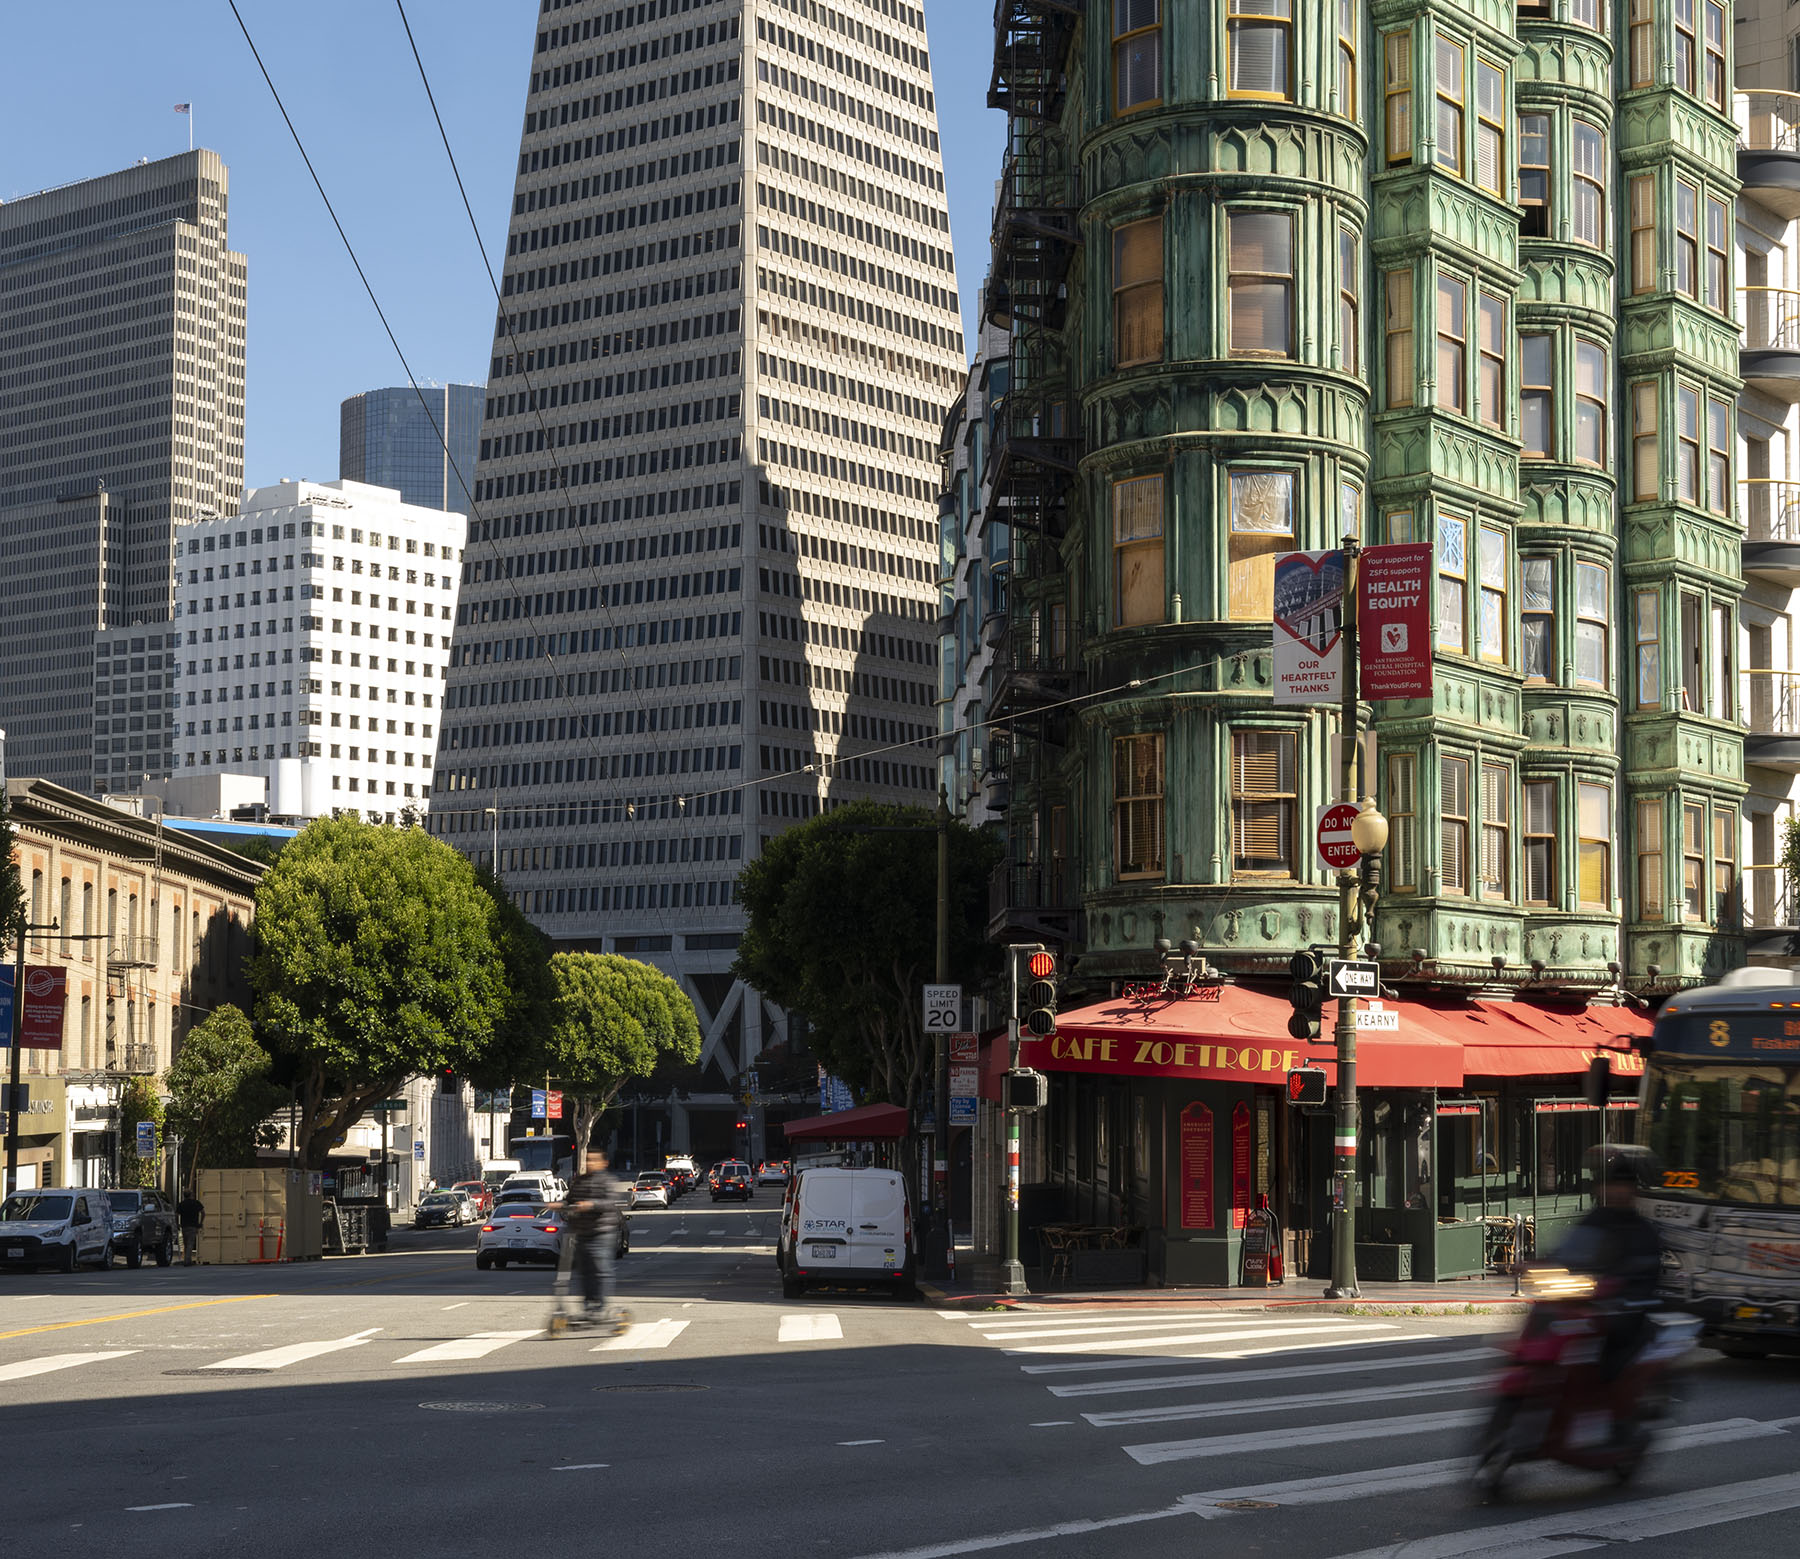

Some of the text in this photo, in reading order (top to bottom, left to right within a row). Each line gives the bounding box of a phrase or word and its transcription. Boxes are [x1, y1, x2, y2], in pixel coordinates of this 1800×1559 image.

[1385, 555, 1412, 564] support
[1369, 567, 1421, 576] ZSFG supports
[1367, 579, 1421, 594] HEALTH
[1368, 595, 1420, 610] EQUITY
[1298, 660, 1319, 669] OUR
[1281, 671, 1337, 682] HEARTFELT
[1288, 684, 1330, 694] THANKS
[1370, 681, 1422, 690] ThankYouSF.org
[1324, 817, 1337, 829] DO
[1328, 845, 1357, 857] ENTER
[1345, 972, 1373, 985] ONE WAY
[927, 990, 959, 998] SPEED
[930, 1000, 955, 1008] LIMIT
[928, 1010, 957, 1028] 20
[1357, 1014, 1396, 1026] KEARNY
[1709, 1020, 1730, 1048] 8
[1051, 1036, 1299, 1073] CAFE ZOETROPE
[816, 1220, 846, 1228] STAR
